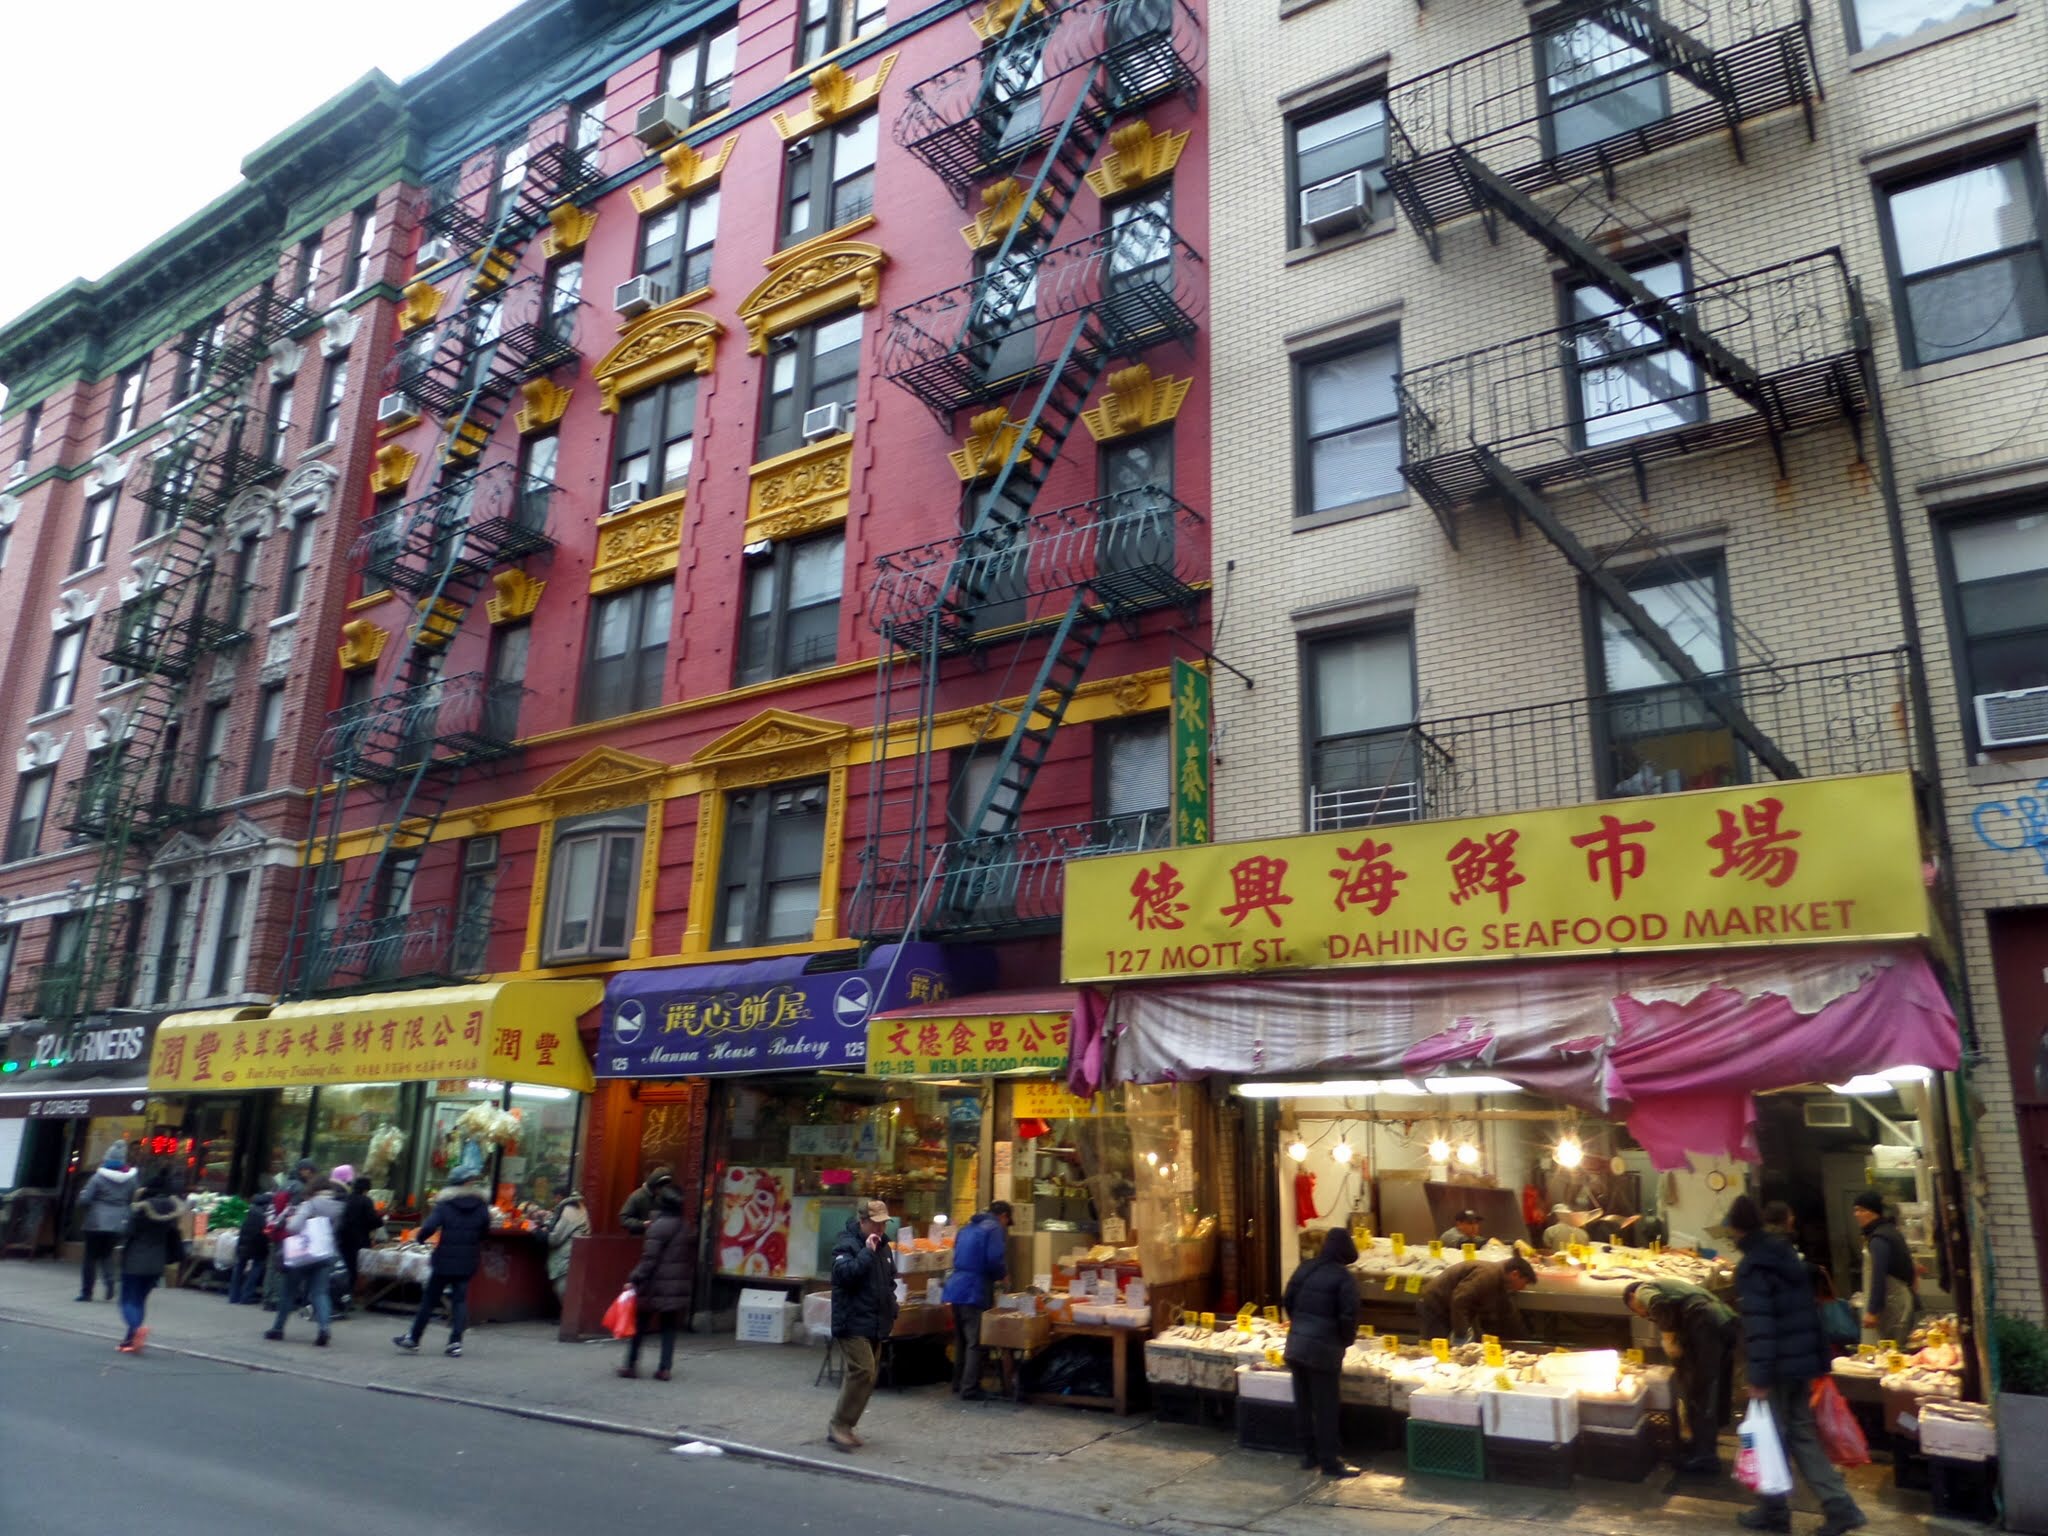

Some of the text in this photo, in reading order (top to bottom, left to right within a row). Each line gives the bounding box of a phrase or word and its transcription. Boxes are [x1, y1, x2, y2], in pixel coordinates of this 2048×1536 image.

[1129, 797, 1802, 931] 德興海鮮市場
[1105, 899, 1856, 975] 127 MOTT ST. DAHING SEAFOOD MARKET
[659, 985, 815, 1037] 麗心餅屋
[493, 1027, 561, 1067] 潤豐
[641, 1035, 830, 1065] Manna House Bakery
[844, 1042, 865, 1057] 125
[887, 1014, 1073, 1057] 文德食品公司
[612, 1058, 629, 1071] 125
[928, 1059, 957, 1073] WEN
[961, 1058, 978, 1073] DE
[982, 1057, 1017, 1072] FOOD
[42, 1099, 90, 1115] CORNERS
